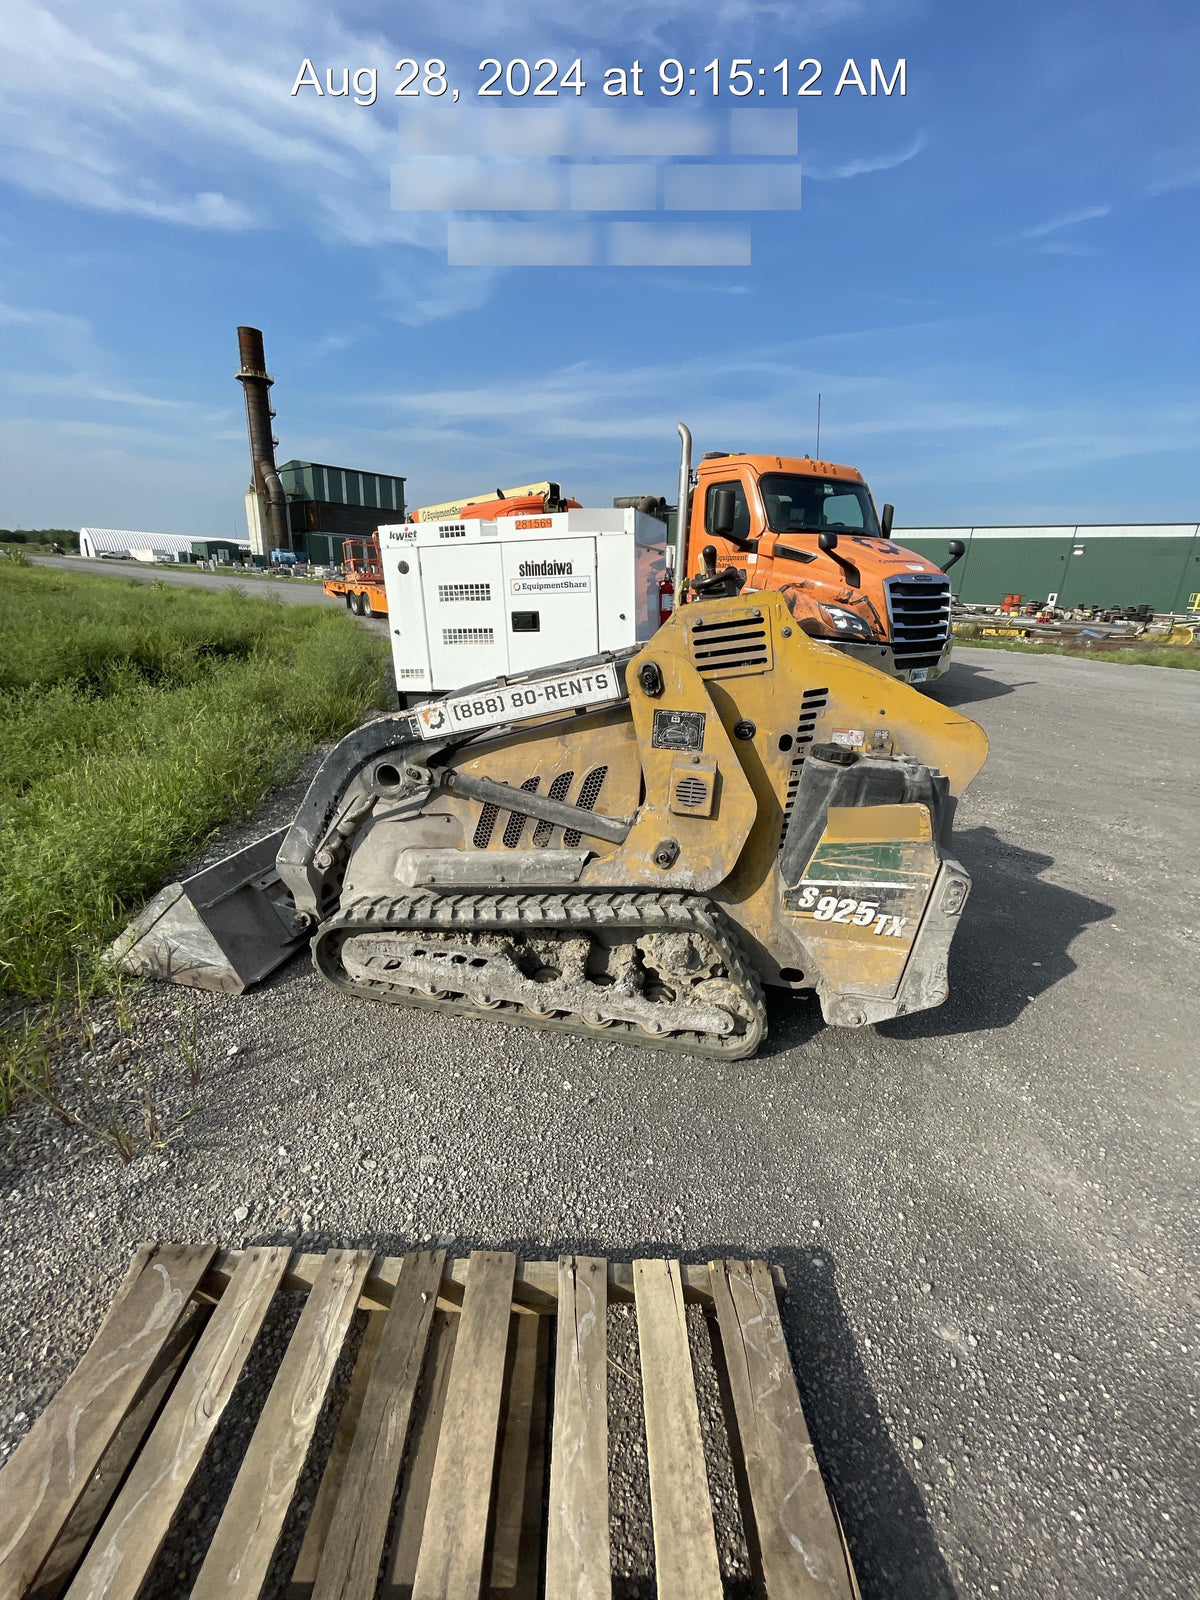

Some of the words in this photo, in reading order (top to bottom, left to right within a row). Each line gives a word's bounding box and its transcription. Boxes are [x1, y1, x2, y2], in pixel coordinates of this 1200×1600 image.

[515, 518, 552, 529] 281569
[389, 527, 417, 541] kwiet
[519, 560, 573, 577] shindaiwa
[522, 581, 587, 591] EquipmentShare
[453, 696, 505, 721] (888)
[512, 674, 609, 708] 80-RENTS
